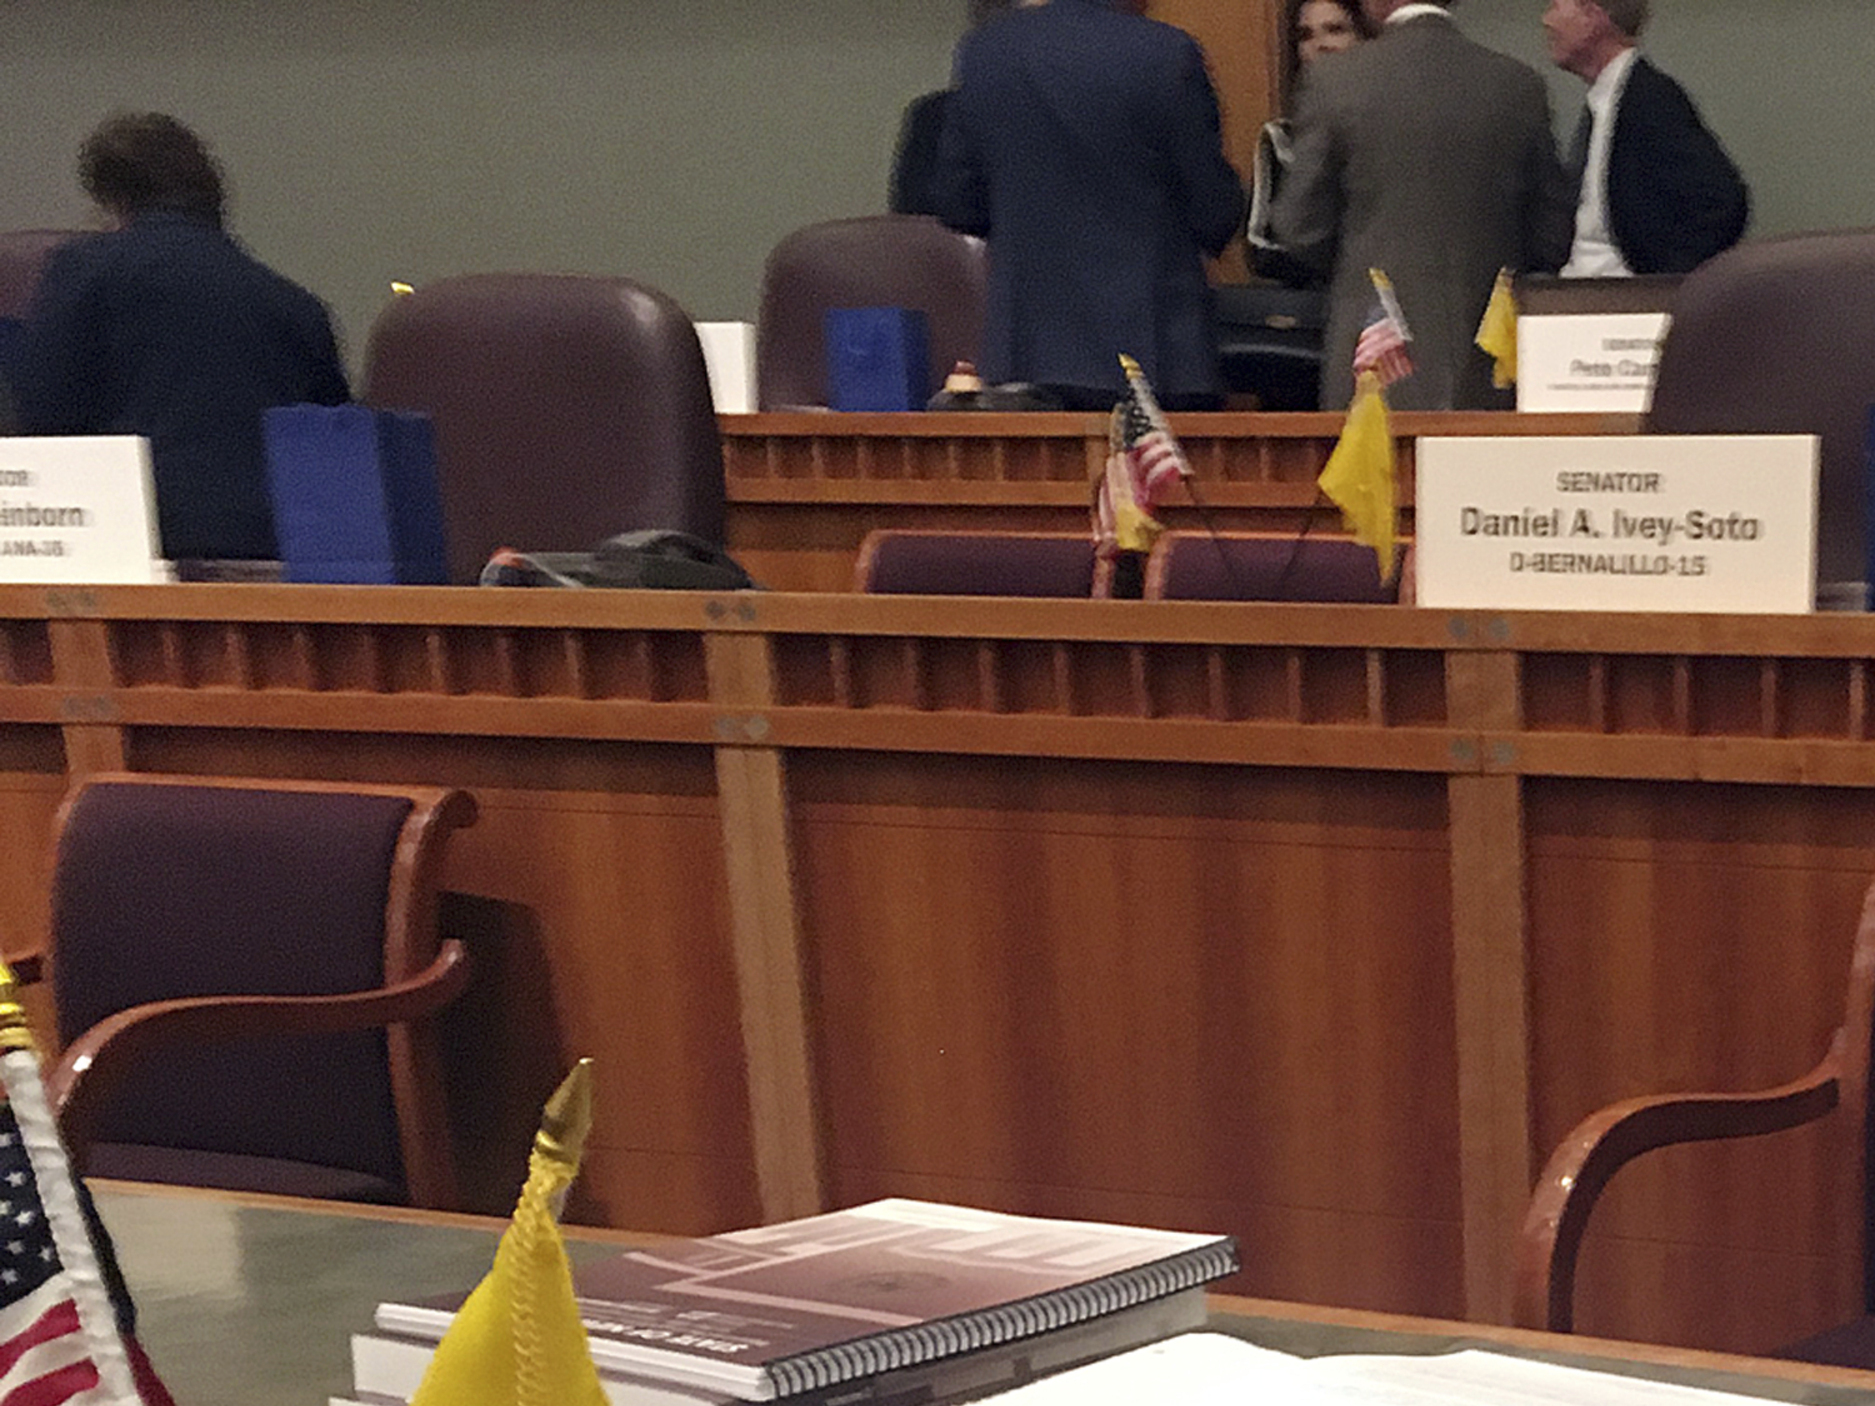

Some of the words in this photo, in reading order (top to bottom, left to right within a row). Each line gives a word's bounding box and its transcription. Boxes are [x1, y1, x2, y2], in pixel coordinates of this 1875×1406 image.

[1556, 472, 1660, 493] SENATOR
[1460, 506, 1559, 538] Daniel
[1569, 508, 1601, 539] A.
[1612, 508, 1763, 546] Ivey-Soto
[1509, 551, 1707, 577] D-BERNALILLO-15
